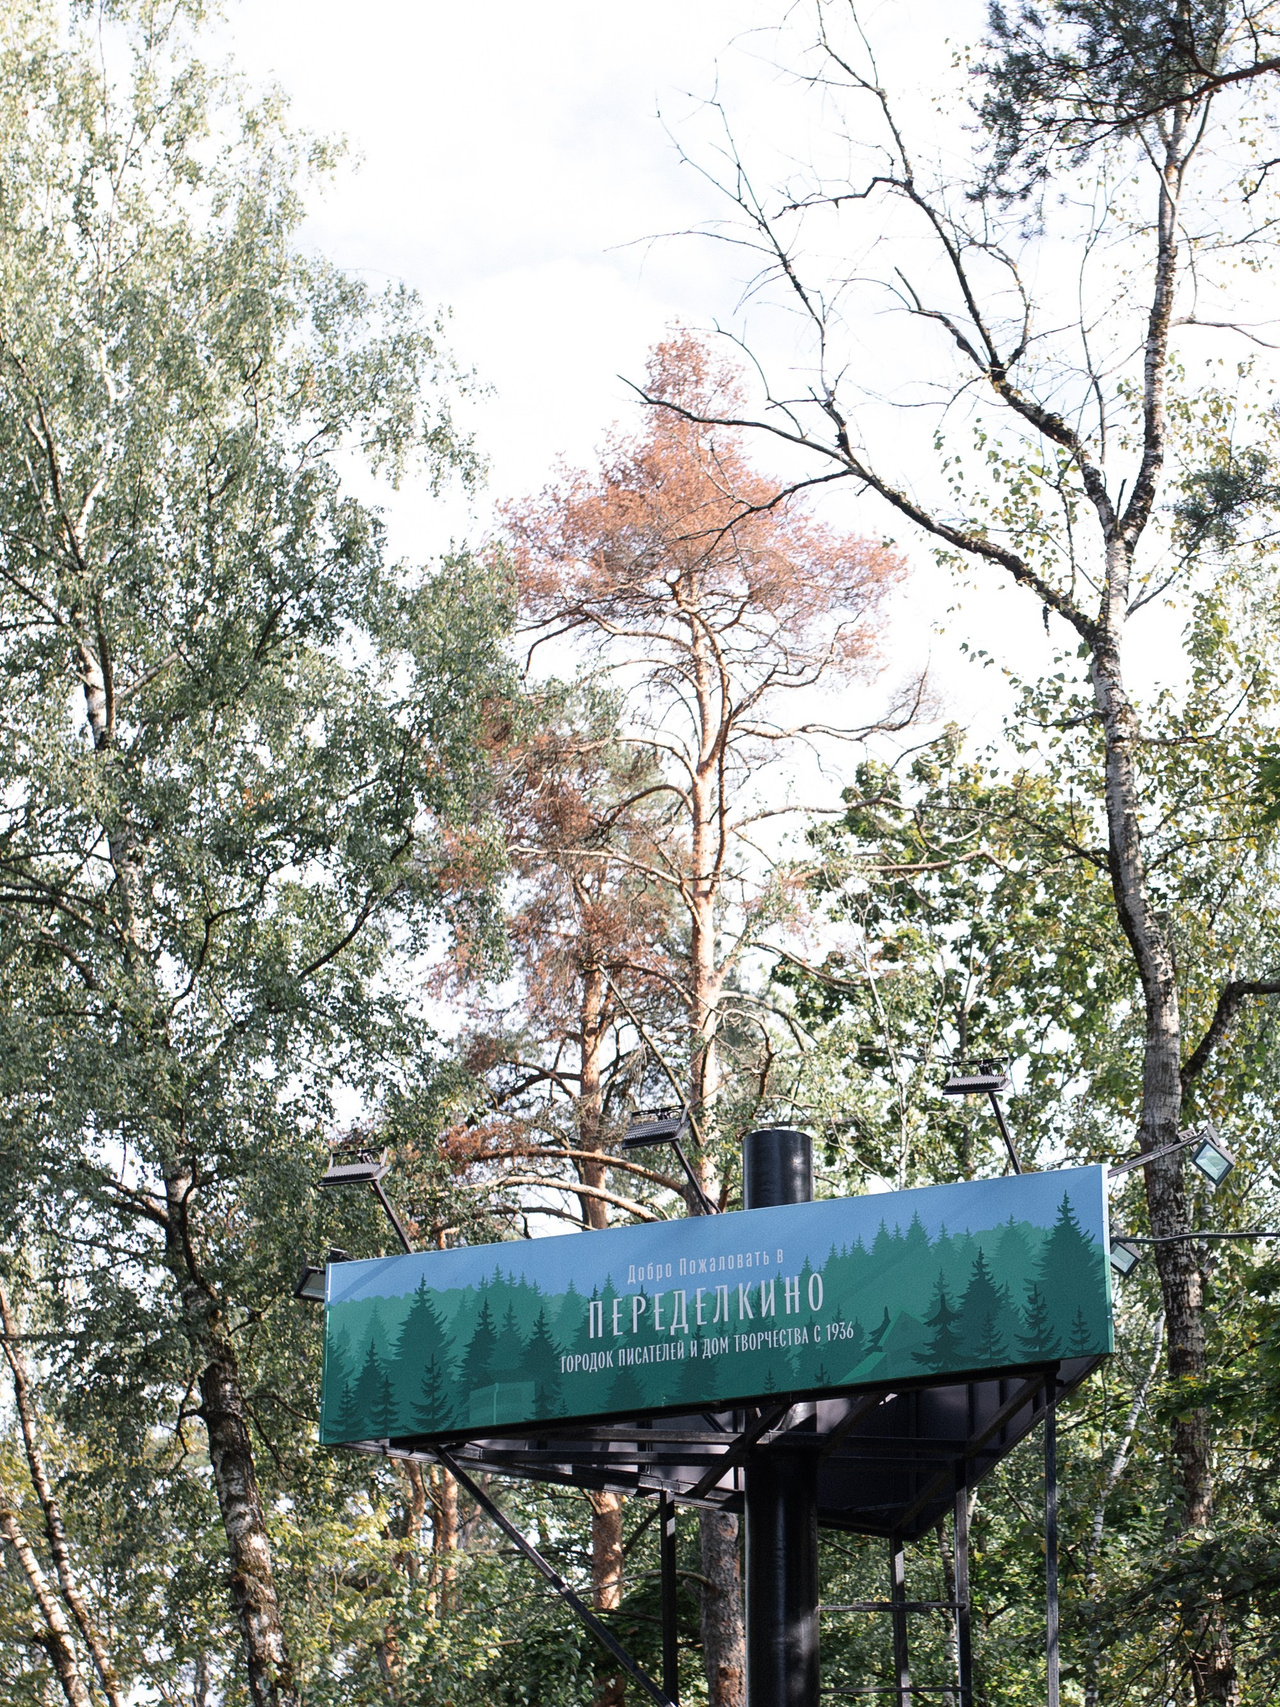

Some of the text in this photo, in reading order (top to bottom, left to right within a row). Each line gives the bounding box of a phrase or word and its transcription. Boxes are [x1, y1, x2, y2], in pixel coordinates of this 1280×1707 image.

[627, 1249, 784, 1285] Добро Пожаловать в
[588, 1273, 824, 1339] ПЕРЕДЕЛКИНО
[560, 1321, 855, 1374] ГОРОДОК ПИСАТЕЛЕЙ И ДОМ ТВОРЧЕСТВА С 1936
